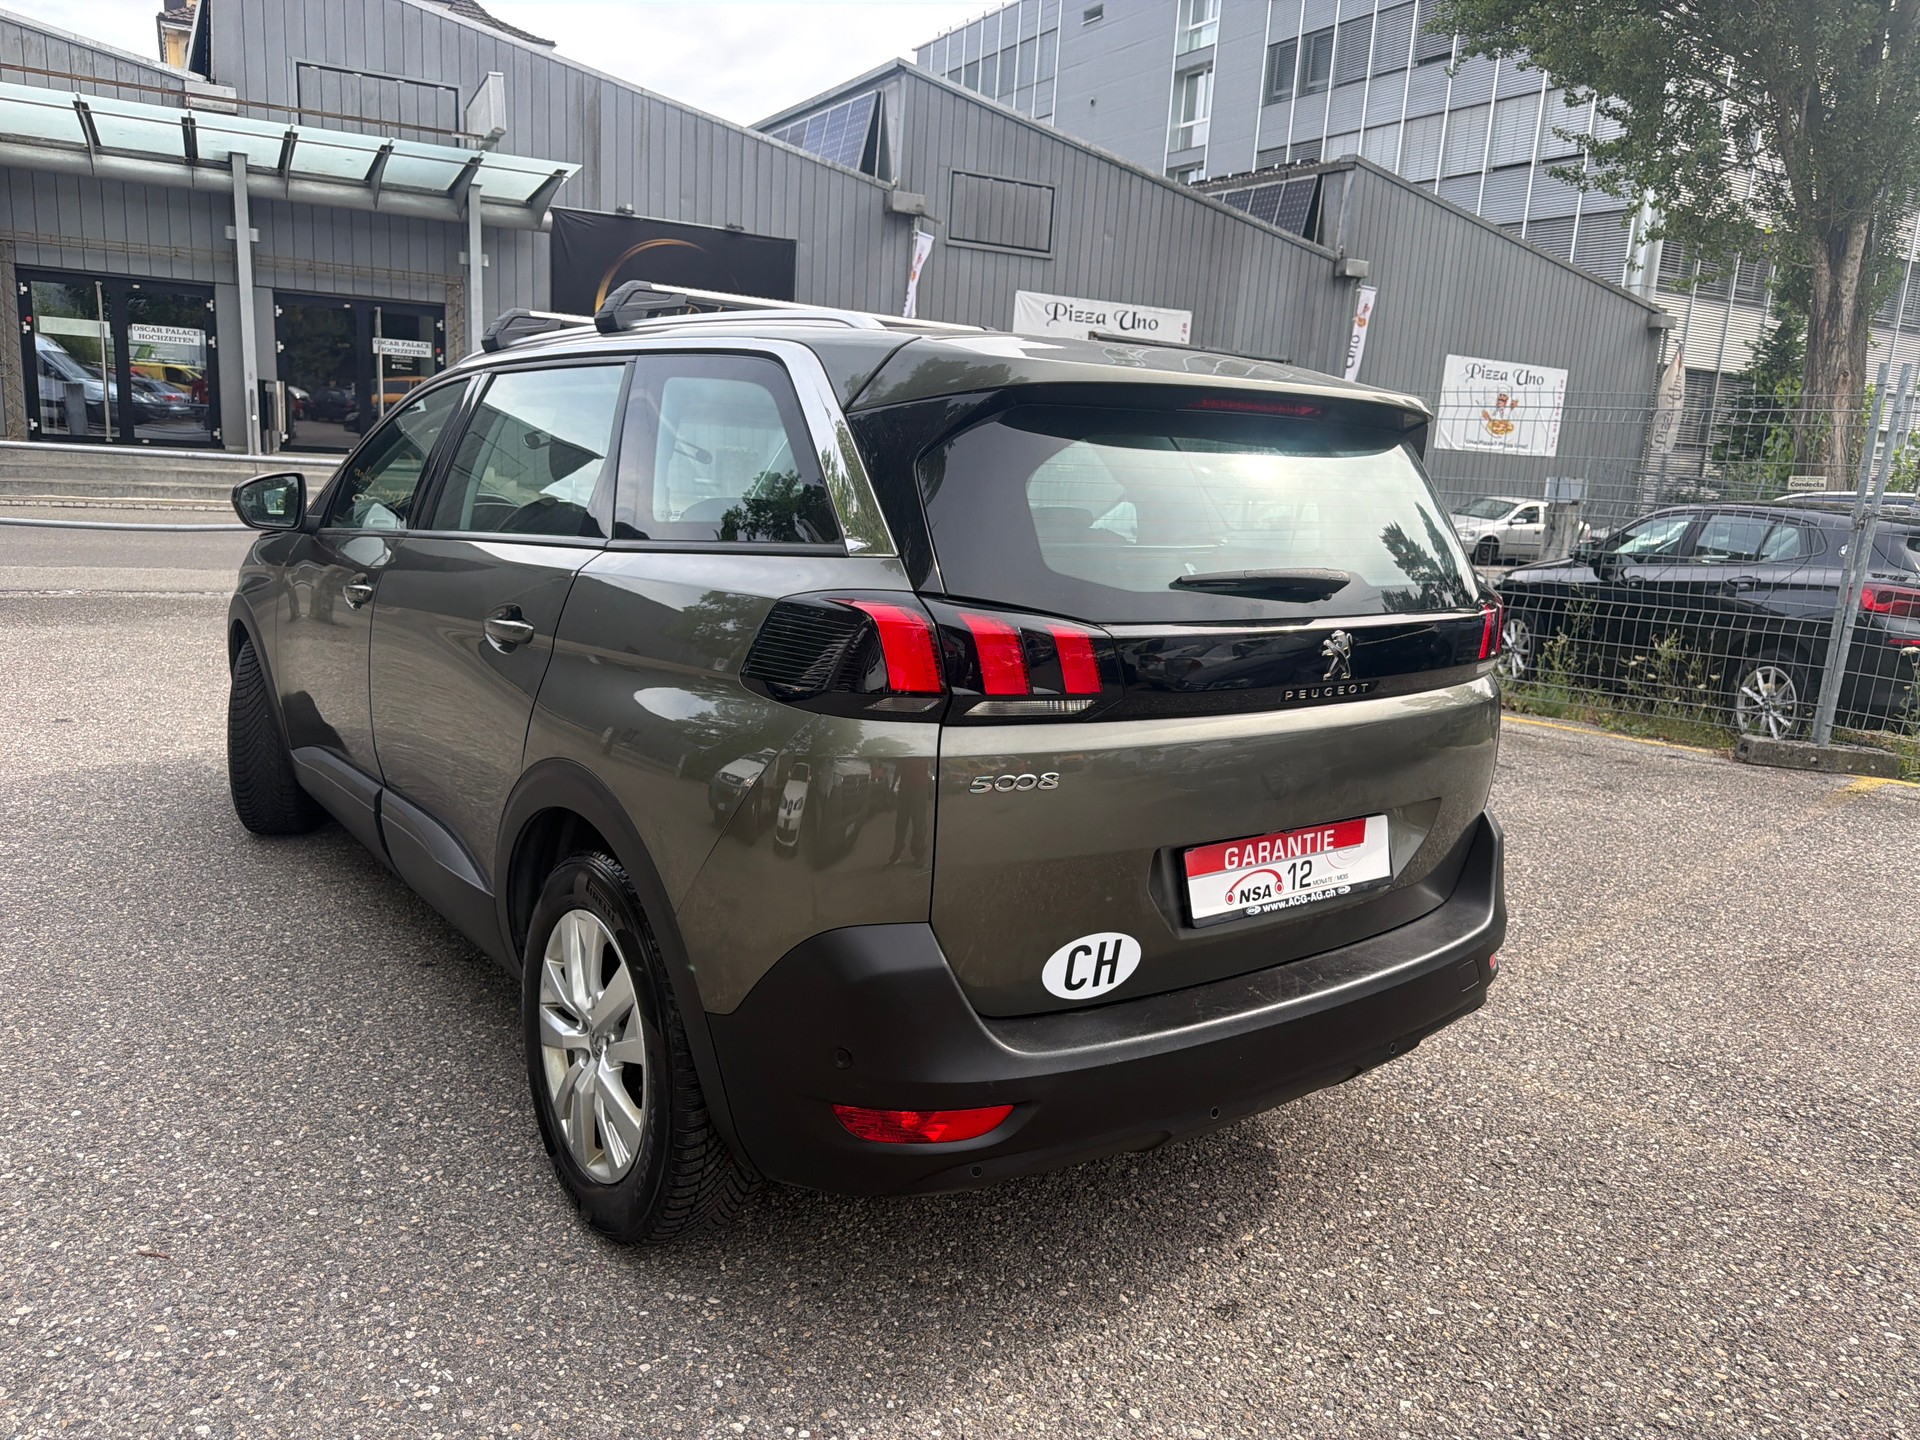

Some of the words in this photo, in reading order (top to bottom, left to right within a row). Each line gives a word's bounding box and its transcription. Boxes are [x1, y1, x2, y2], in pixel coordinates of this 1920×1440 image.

[1045, 302, 1106, 328] Pizza
[1113, 310, 1159, 331] Uno
[133, 325, 163, 333] OSCAR
[165, 328, 199, 337] PALACE
[138, 333, 195, 343] HOCHZEITEN
[1465, 363, 1508, 384] Pizza
[1512, 369, 1544, 386] Uno
[1666, 375, 1682, 405] Uno
[1285, 683, 1369, 700] PEUGEOT
[969, 772, 1060, 794] 5008
[1224, 829, 1335, 870] GARANTIE
[1287, 860, 1313, 890] 12
[1312, 876, 1333, 886] MONATE
[1337, 872, 1349, 880] MOIS
[1239, 884, 1272, 904] NSA
[1262, 887, 1337, 913] www.ACG-AG.ch
[1064, 938, 1123, 991] CH
